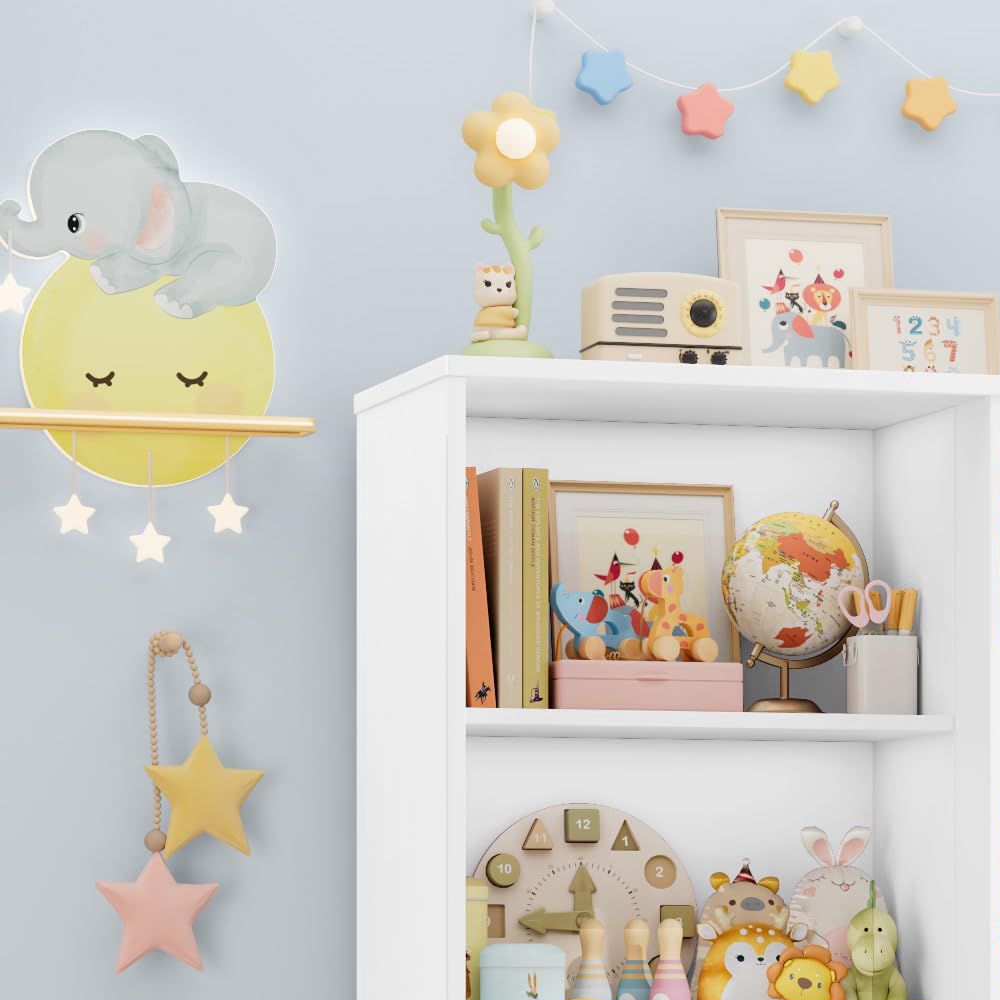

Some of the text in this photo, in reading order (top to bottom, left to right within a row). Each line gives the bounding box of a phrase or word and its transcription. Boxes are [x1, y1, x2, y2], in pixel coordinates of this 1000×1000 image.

[908, 315, 923, 335] 2
[928, 315, 940, 336] 3
[946, 316, 959, 336] 4
[901, 338, 957, 362] 5 6 7
[575, 819, 591, 830] 12
[533, 833, 548, 843] 11
[621, 836, 629, 847] 1
[497, 863, 512, 874] 10
[655, 867, 664, 878] 2
